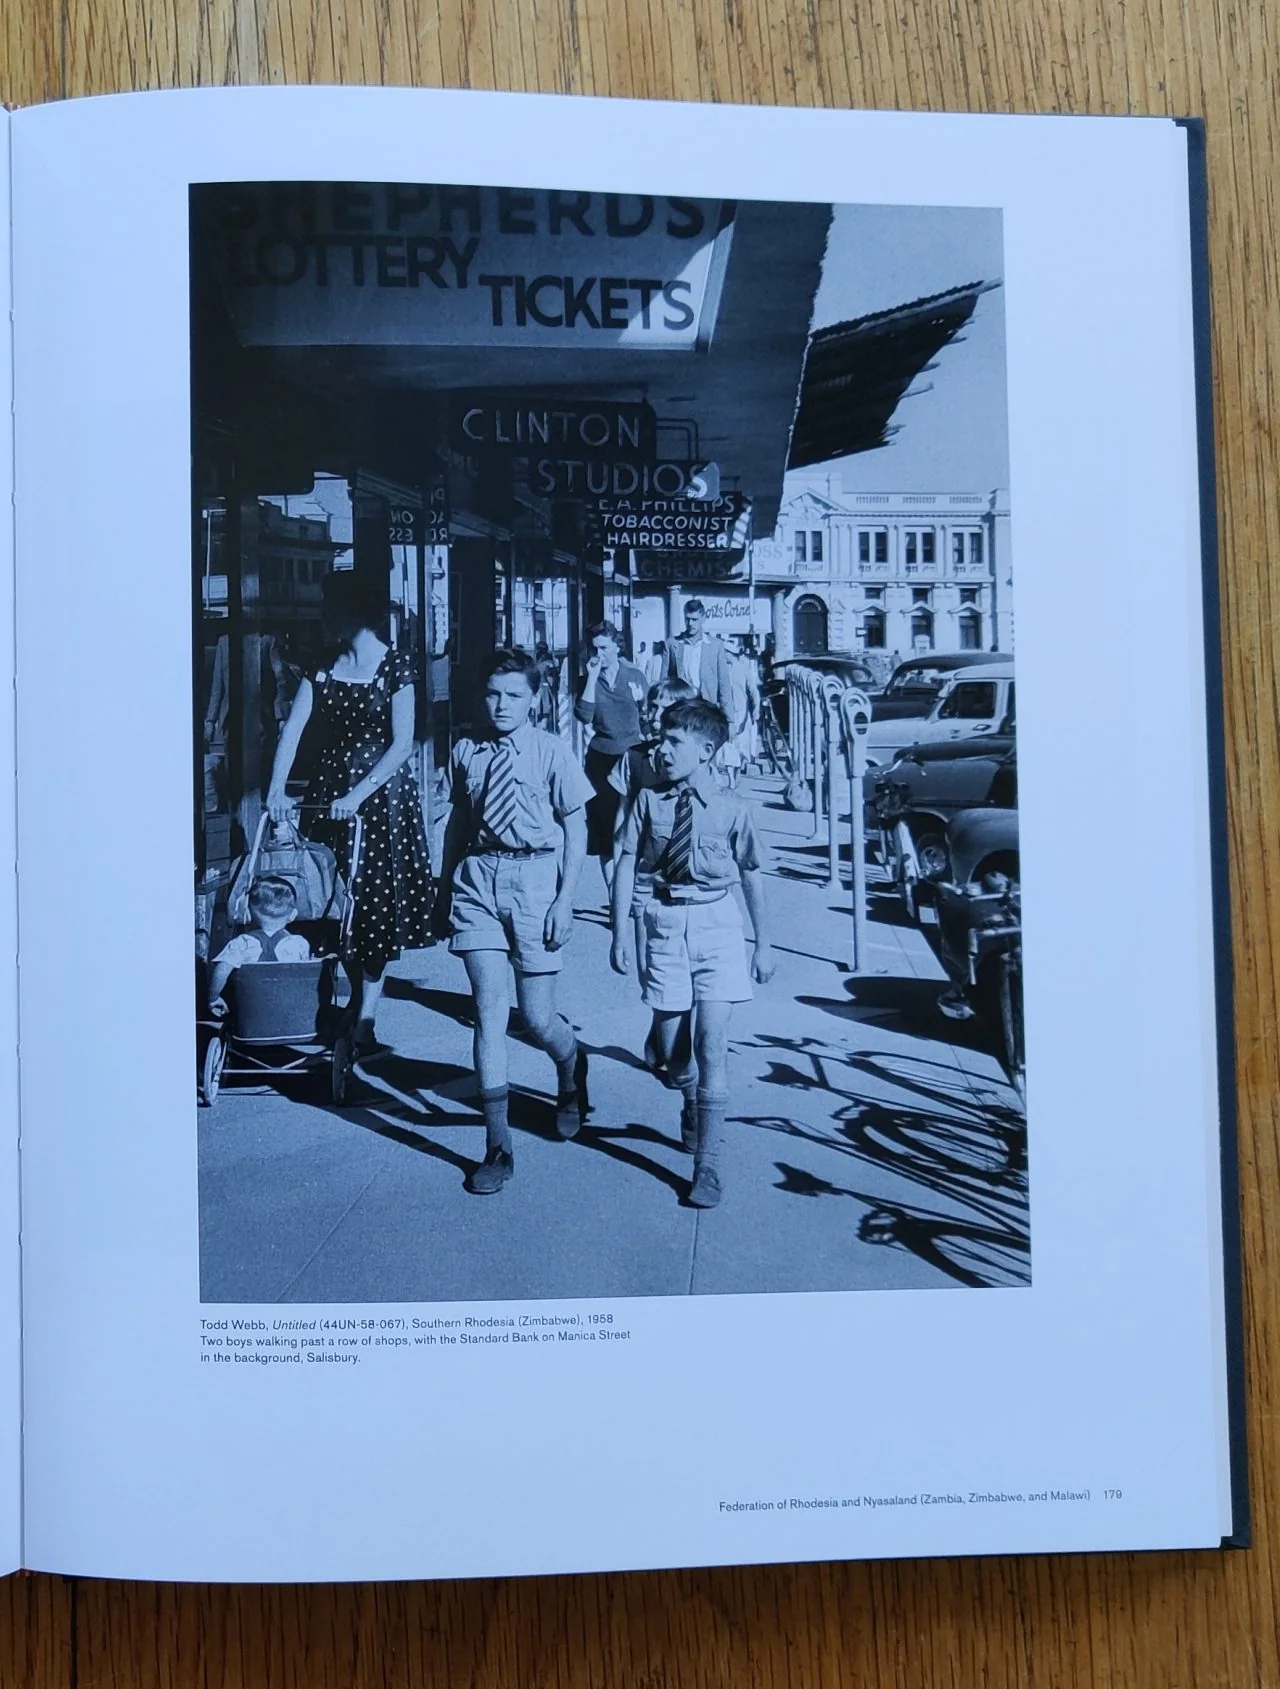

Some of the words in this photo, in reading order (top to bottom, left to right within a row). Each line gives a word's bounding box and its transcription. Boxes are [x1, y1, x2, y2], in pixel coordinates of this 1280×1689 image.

[230, 233, 480, 289] LOTTERY
[478, 274, 696, 331] TICKETS
[461, 407, 641, 448] CLINTON
[536, 459, 708, 500] STUDIOS
[601, 513, 733, 532] TOBACCONIST
[607, 532, 729, 548] HAIRDRESSER
[640, 559, 731, 578] CHEMIS
[724, 599, 757, 618] Corne
[199, 1318, 229, 1331] Todd
[230, 1318, 269, 1333] Webb,
[272, 1318, 317, 1332] Untitled
[319, 1317, 409, 1333] (44UN-58-067),
[411, 1316, 462, 1330] Southern
[464, 1315, 515, 1329] Rhodesia
[518, 1312, 584, 1328] (Zimbabwe),
[587, 1312, 614, 1325] 1958
[199, 1334, 224, 1347] Two
[226, 1334, 253, 1350] boys
[255, 1334, 298, 1351] walking
[300, 1336, 325, 1350] past
[327, 1337, 335, 1348] a
[337, 1337, 359, 1347] row
[360, 1334, 372, 1347] of
[374, 1334, 412, 1349] shops,
[413, 1333, 437, 1346] with
[439, 1332, 457, 1346] the
[459, 1331, 509, 1345] Standard
[511, 1330, 540, 1344] Bank
[541, 1333, 555, 1343] on
[557, 1329, 596, 1342] Manica
[598, 1328, 631, 1341] Street
[200, 1351, 211, 1364] in
[213, 1350, 231, 1364] the
[234, 1350, 304, 1367] background,
[306, 1350, 361, 1366] Salisbury.
[719, 1499, 775, 1513] Federation
[776, 1497, 787, 1511] of
[789, 1496, 839, 1511] Rhodesia
[841, 1495, 861, 1509] and
[863, 1493, 918, 1510] Nyasaland
[920, 1492, 966, 1506] (Zambia,
[968, 1491, 1026, 1504] Zimbabwe,
[1028, 1490, 1048, 1503] and
[1050, 1488, 1091, 1502] Malawi)
[1104, 1488, 1123, 1501] 179
